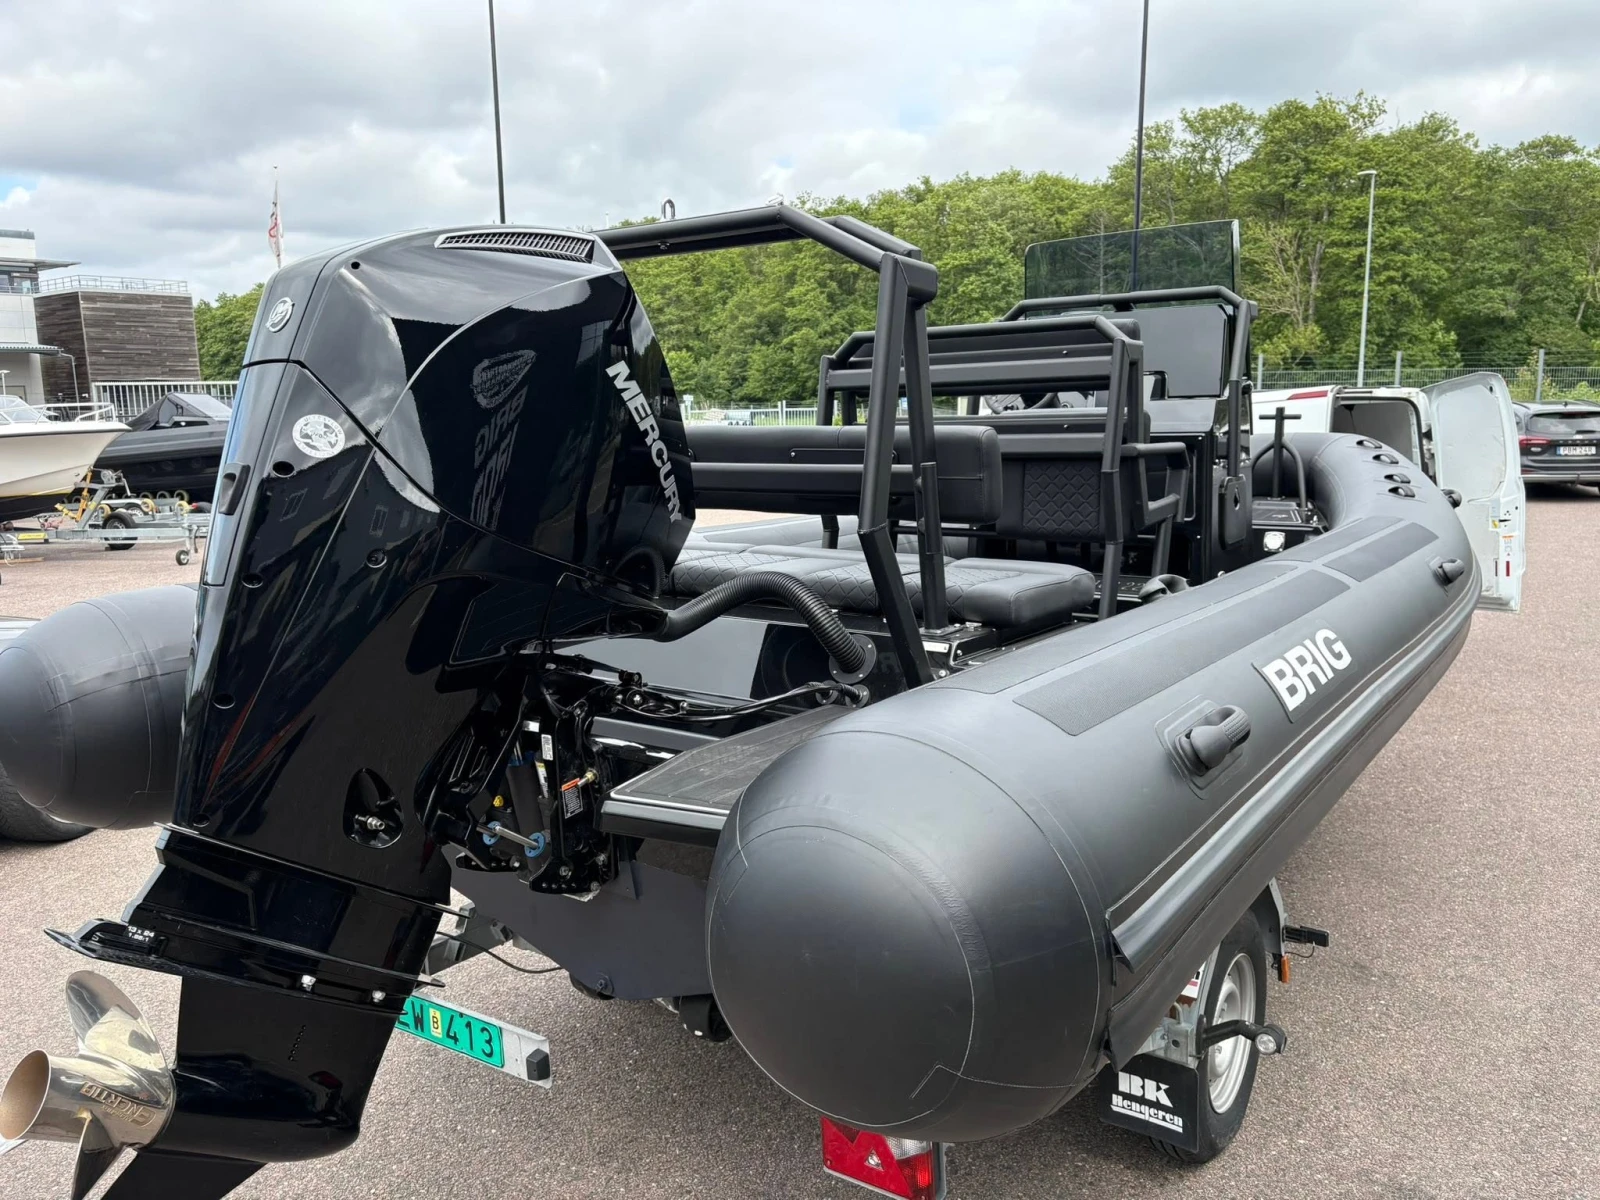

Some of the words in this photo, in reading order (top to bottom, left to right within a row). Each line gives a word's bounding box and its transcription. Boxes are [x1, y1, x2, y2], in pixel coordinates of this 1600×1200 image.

[605, 360, 682, 523] MERCURY
[1262, 629, 1352, 711] BRIG
[431, 1015, 440, 1030] B
[446, 1014, 494, 1058] 413
[1118, 1071, 1174, 1108] BK
[1111, 1093, 1183, 1127] Hengeren
